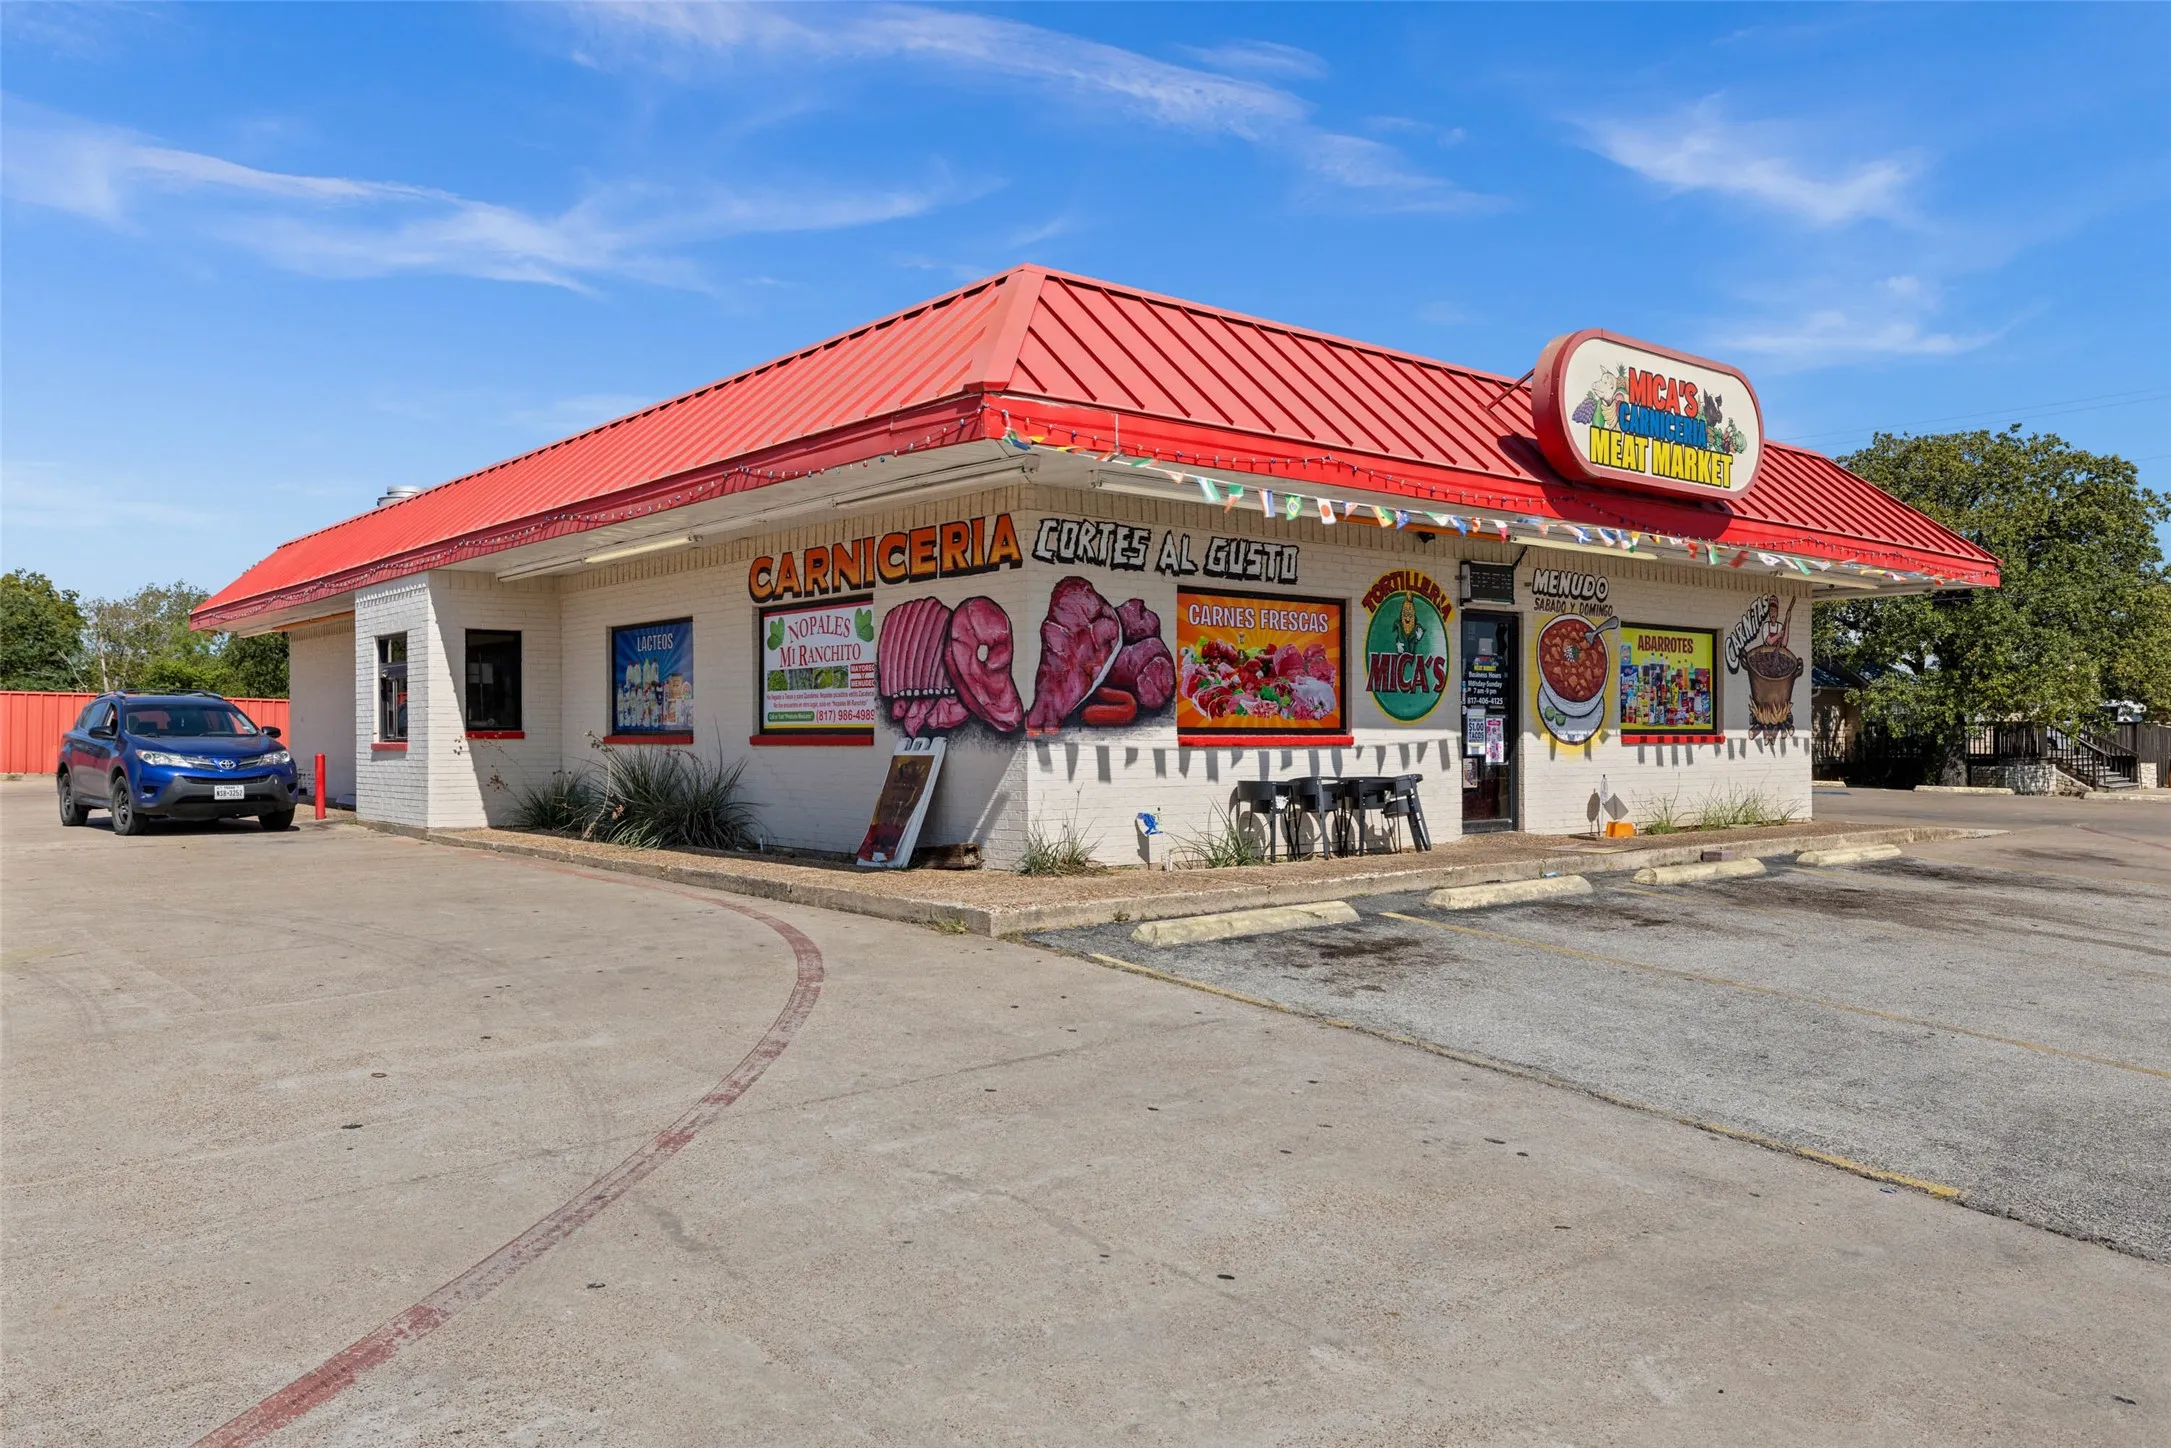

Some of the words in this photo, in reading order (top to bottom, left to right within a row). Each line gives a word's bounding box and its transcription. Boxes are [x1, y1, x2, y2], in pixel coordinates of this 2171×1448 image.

[1628, 366, 1699, 418] MICA'S
[1618, 401, 1708, 449] CARNICERIA
[1589, 425, 1649, 473] MEAT
[1652, 439, 1734, 489] MARKET
[749, 513, 1023, 603] CARNICERIA
[1032, 518, 1152, 572] CORTES
[1155, 530, 1199, 576] AL
[1203, 536, 1300, 584] GUSTO
[1362, 570, 1453, 622] TORTILLERIA
[1532, 568, 1609, 602] MENUDO
[1188, 604, 1255, 629] CARNES
[1260, 609, 1329, 633] FRESCAS
[1534, 597, 1566, 614] SABADO
[1570, 600, 1576, 613] Y
[1579, 601, 1613, 617] DOMINGO
[637, 633, 674, 652] LACTEOS
[787, 614, 851, 643] NOPALES
[1637, 634, 1694, 654] ABARROTES
[1725, 593, 1770, 674] CARNITAS
[1365, 652, 1447, 694] MICA'S
[816, 709, 836, 723] (817)
[1468, 722, 1485, 732] $1.00
